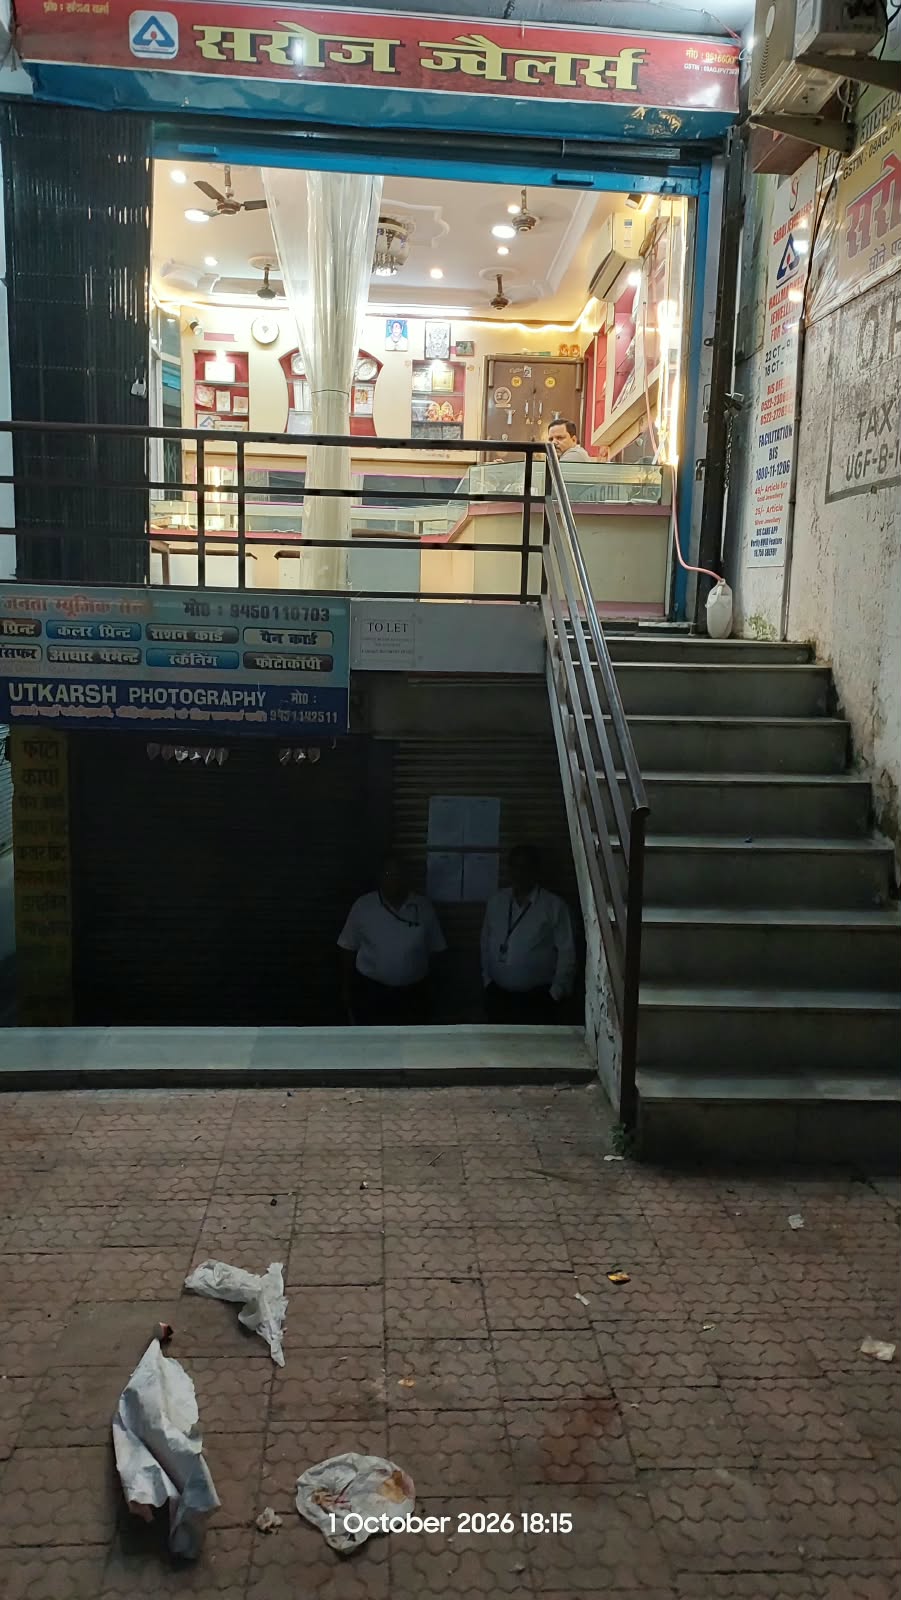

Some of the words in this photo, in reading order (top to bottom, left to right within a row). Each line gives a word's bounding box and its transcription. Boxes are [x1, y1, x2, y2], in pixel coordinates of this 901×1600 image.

[193, 20, 402, 74] सरोज
[231, 604, 330, 622] 9450110703
[56, 625, 95, 638] कलर
[368, 622, 384, 633] TO
[387, 622, 408, 633] LET
[8, 683, 117, 704] UTKARSH
[129, 687, 266, 707] PHOTOGRAPHY
